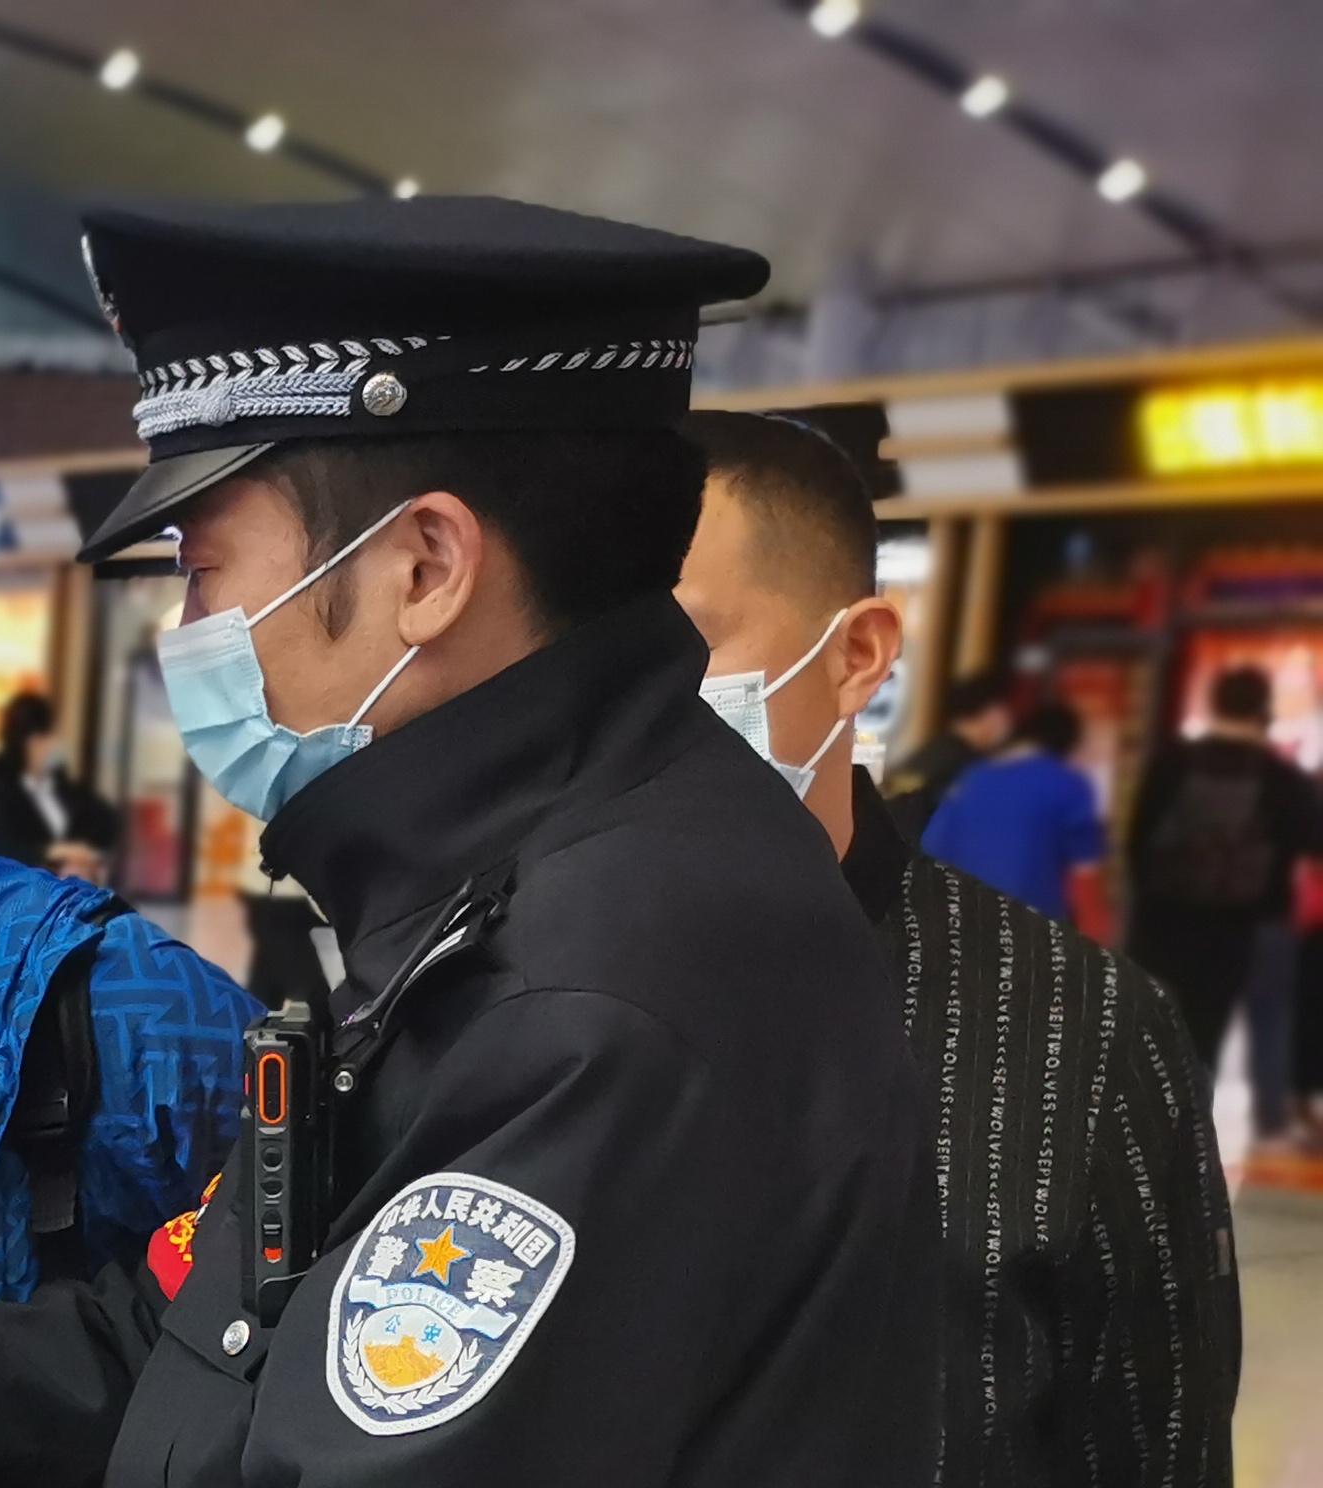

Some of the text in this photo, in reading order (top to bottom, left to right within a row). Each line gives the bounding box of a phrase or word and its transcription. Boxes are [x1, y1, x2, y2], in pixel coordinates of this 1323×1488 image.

[996, 929, 1012, 1033] SEPTWOLVES
[940, 999, 959, 1103] SEPTWOLVES
[1041, 1005, 1064, 1111] SEPTWOLVES
[987, 1067, 1006, 1170] SEPTWOLVES
[366, 1235, 524, 1308] 警 察
[379, 1189, 556, 1268] 中华人民共和国
[385, 1286, 466, 1320] POLICE
[421, 1322, 441, 1345] 安
